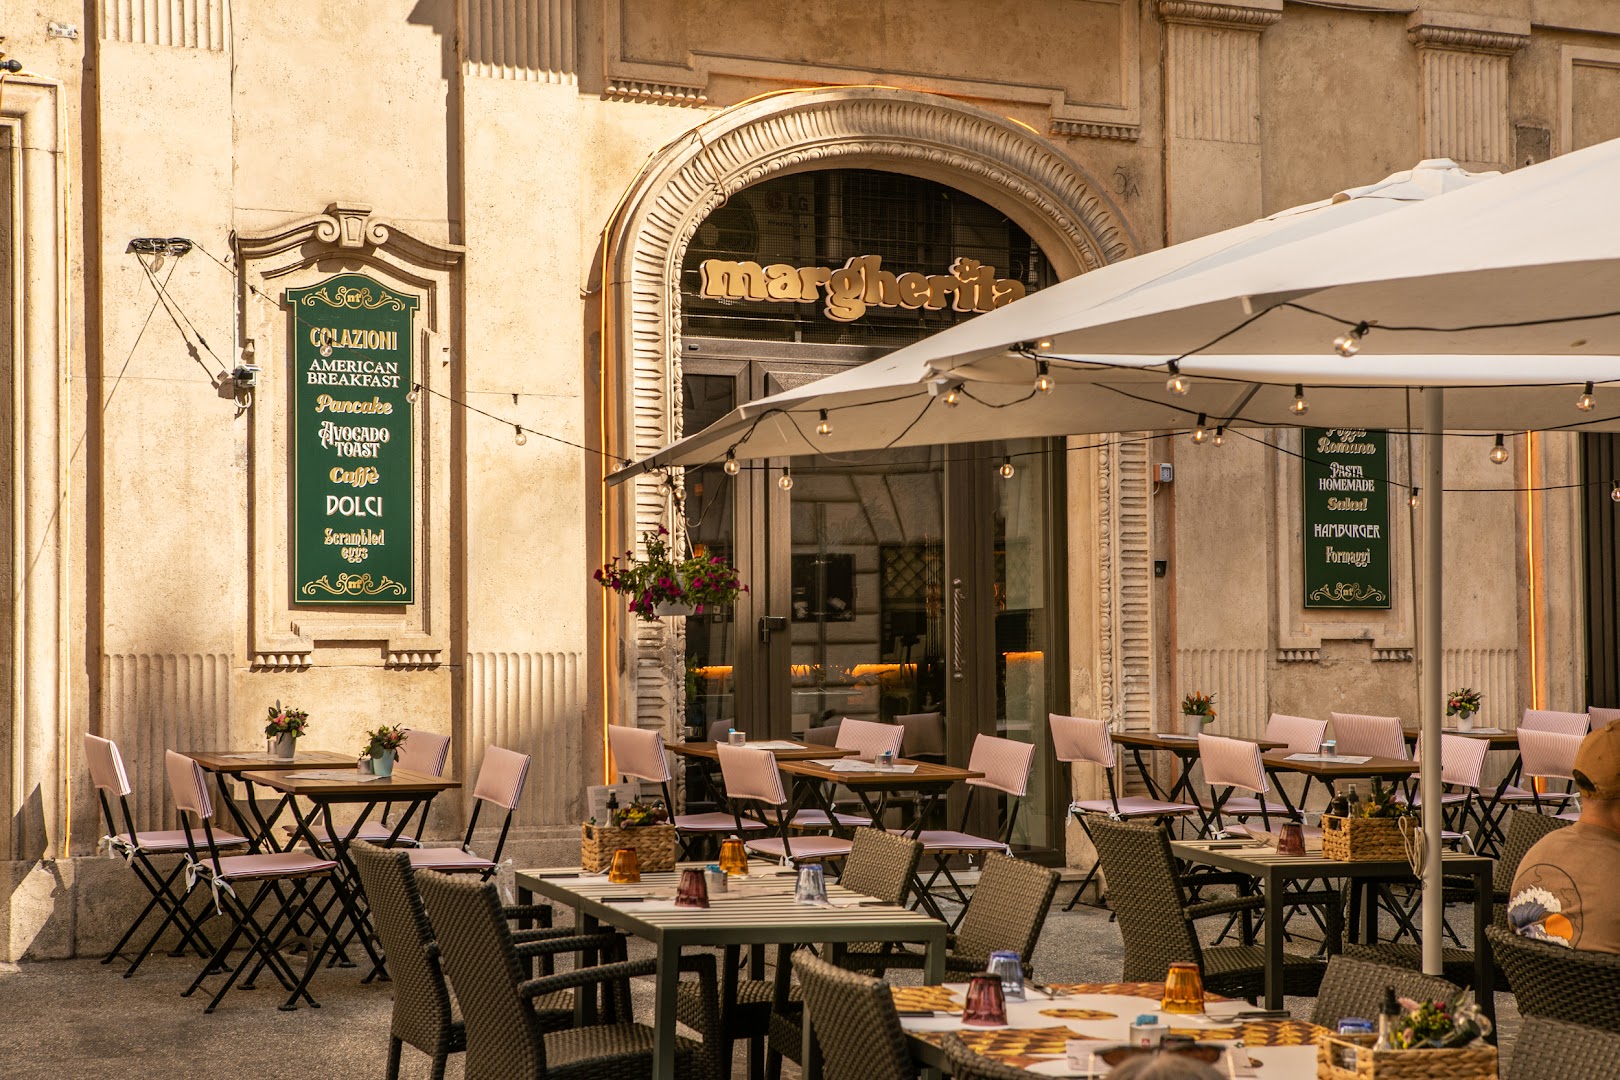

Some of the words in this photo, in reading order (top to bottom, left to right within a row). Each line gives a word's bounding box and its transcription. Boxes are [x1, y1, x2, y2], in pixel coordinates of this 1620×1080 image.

[700, 254, 1026, 323] margherita
[309, 327, 398, 350] COLAZIONI
[308, 358, 398, 374] AMERICAN
[307, 372, 400, 388] BREAKFAST
[315, 394, 393, 415] Pancake
[334, 442, 380, 458] TOAST
[1317, 436, 1376, 455] Romana
[329, 466, 380, 487] Caffè
[1329, 461, 1364, 479] PASTA
[1319, 478, 1375, 492] HOMEMADE
[326, 495, 383, 517] DOLCI
[1327, 497, 1368, 512] Salad
[323, 528, 385, 547] Scrambled
[1314, 523, 1380, 539] HAMBURGER
[341, 546, 368, 563] eggs
[1325, 545, 1371, 568] Formaggi
